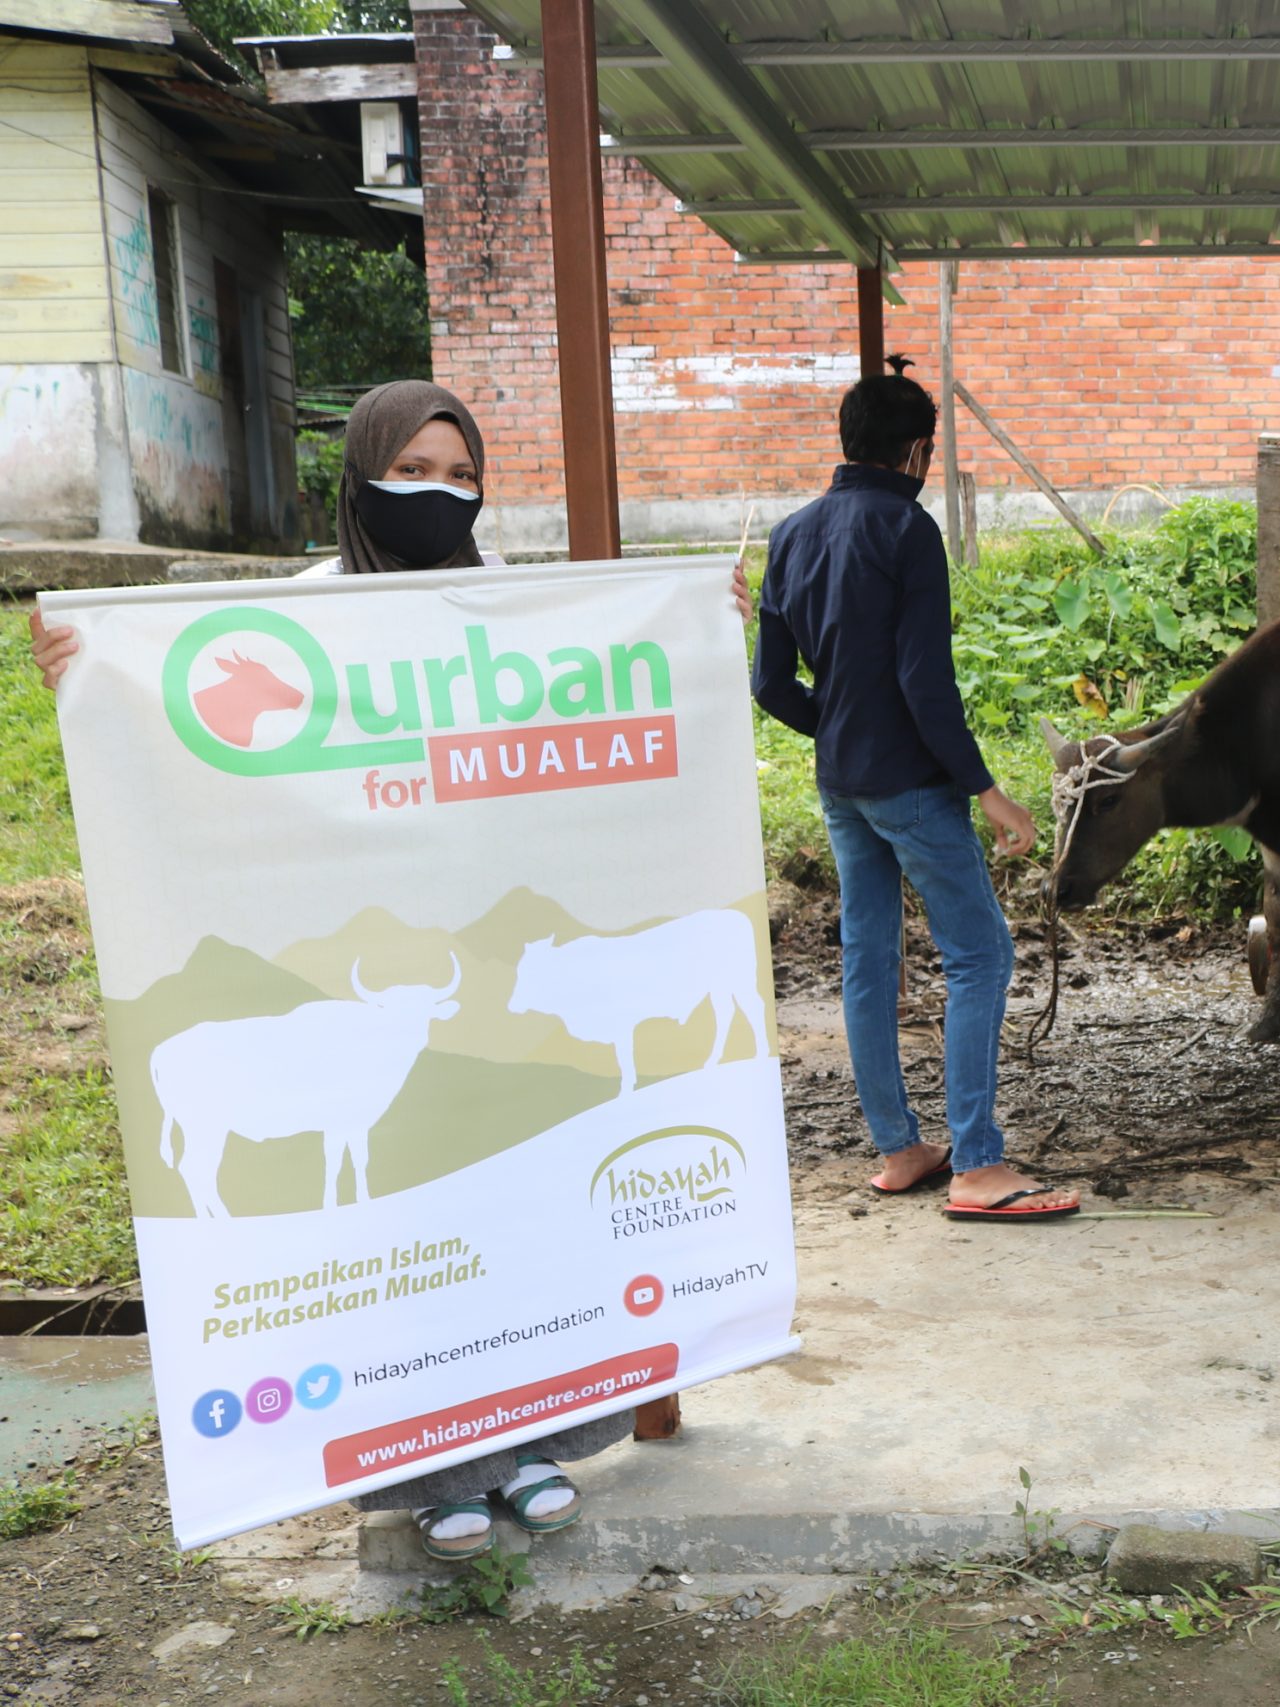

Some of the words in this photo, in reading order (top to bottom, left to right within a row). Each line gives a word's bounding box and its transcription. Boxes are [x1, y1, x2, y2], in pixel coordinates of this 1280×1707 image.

[362, 769, 428, 809] for
[449, 729, 665, 784] MUALAF
[611, 1197, 683, 1224] CENTRE
[611, 1199, 737, 1241] FOUNDATION
[201, 1288, 378, 1344] Perkasakan
[384, 1254, 488, 1301] Mualaf.
[212, 1256, 382, 1310] Sampaikan
[389, 1236, 470, 1271] Islam,
[671, 1261, 769, 1299] HidayahTV
[353, 1305, 605, 1387] hidayahcentrefoundation
[356, 1365, 652, 1467] www.hidayahcentre.org.my
